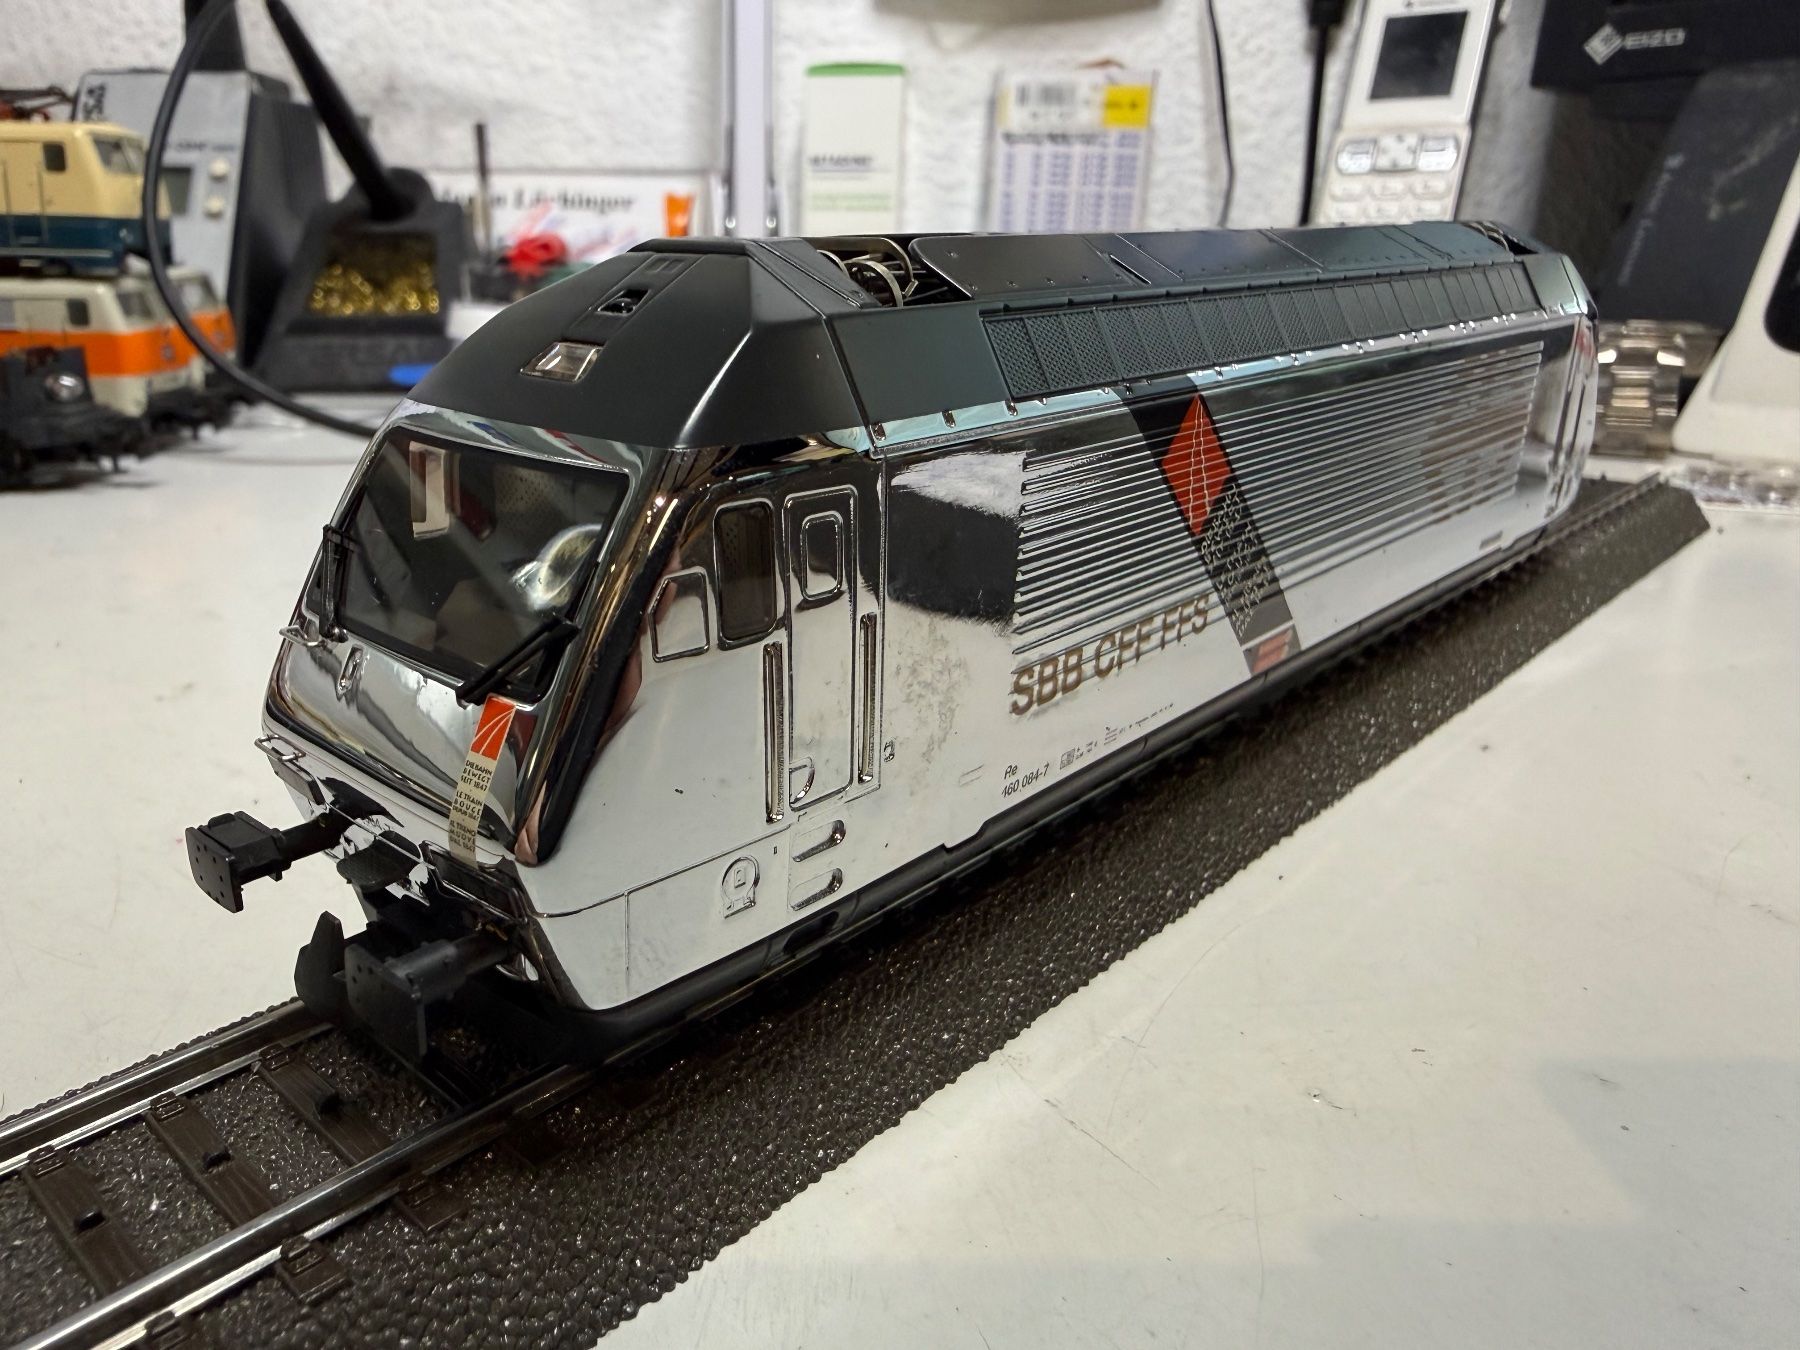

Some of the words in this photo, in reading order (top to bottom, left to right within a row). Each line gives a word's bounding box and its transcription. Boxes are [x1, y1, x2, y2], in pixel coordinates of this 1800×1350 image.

[1011, 646, 1083, 715] SBB
[1094, 617, 1154, 679] CFF
[463, 767, 491, 784] BEWEGT
[1004, 764, 1018, 780] Re
[473, 780, 488, 791] 1847
